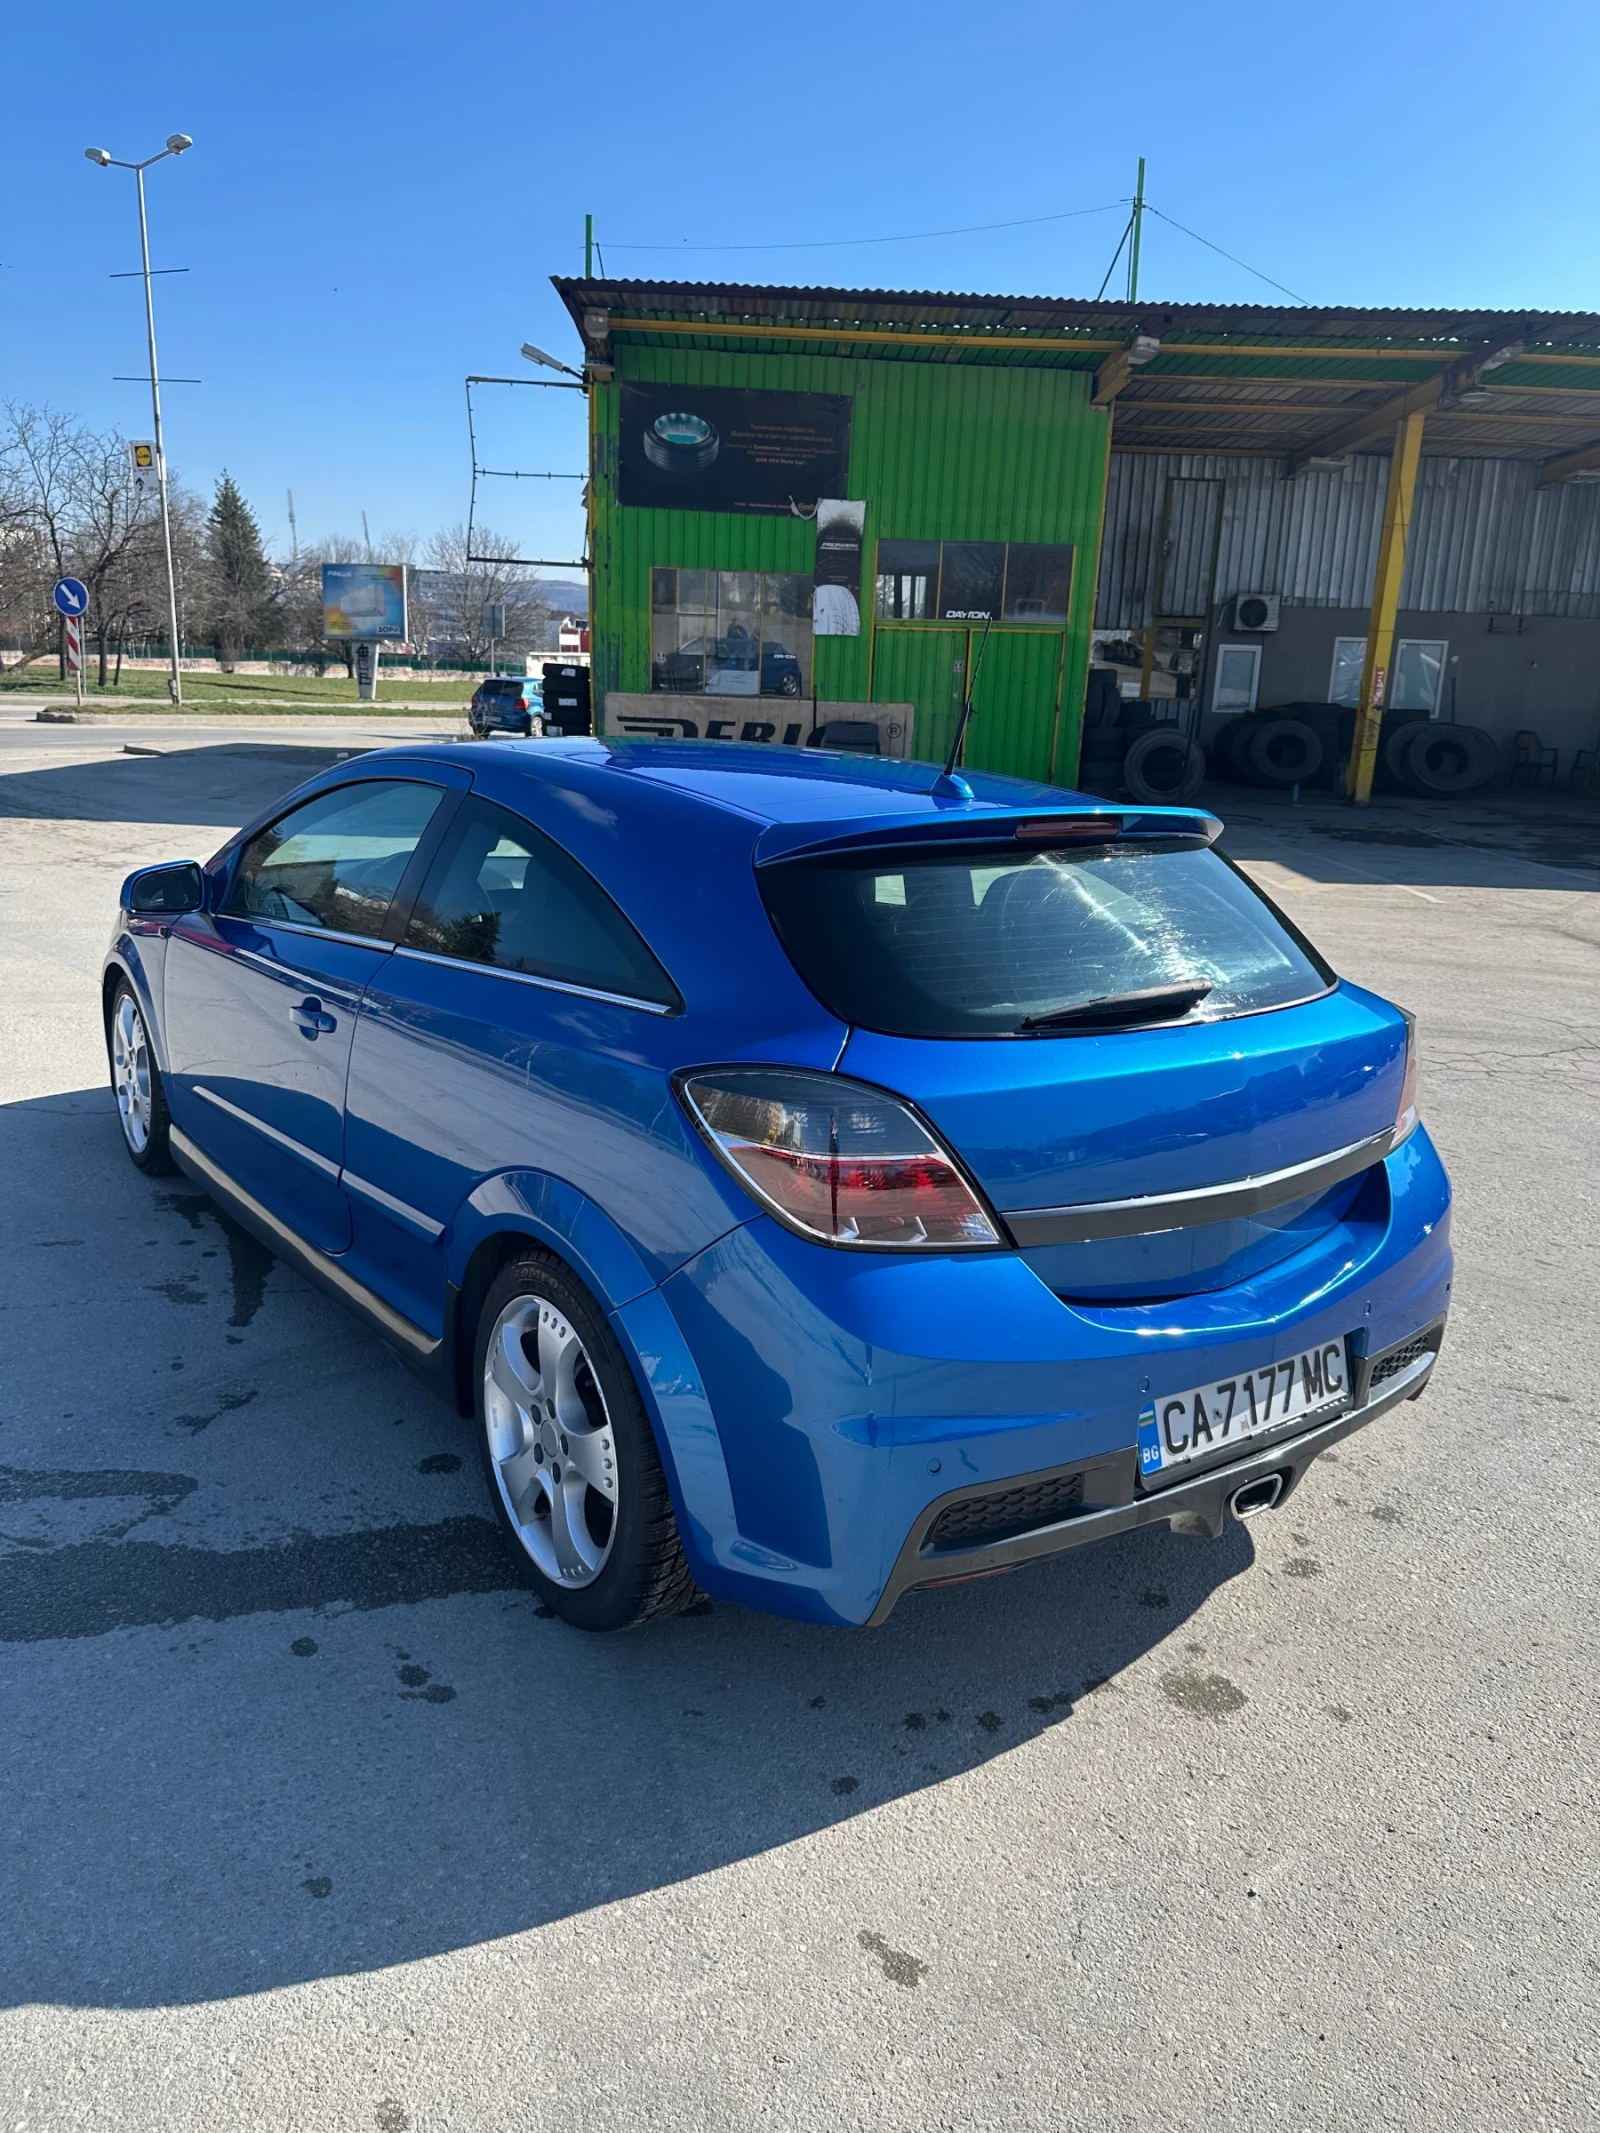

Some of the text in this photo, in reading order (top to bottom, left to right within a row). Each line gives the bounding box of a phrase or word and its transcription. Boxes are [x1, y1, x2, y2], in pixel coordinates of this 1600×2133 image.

[946, 610, 990, 620] DAYTON
[377, 625, 400, 634] ЗОРА
[1163, 1343, 1342, 1455] CA 7177 MC
[1142, 1444, 1160, 1464] BG
